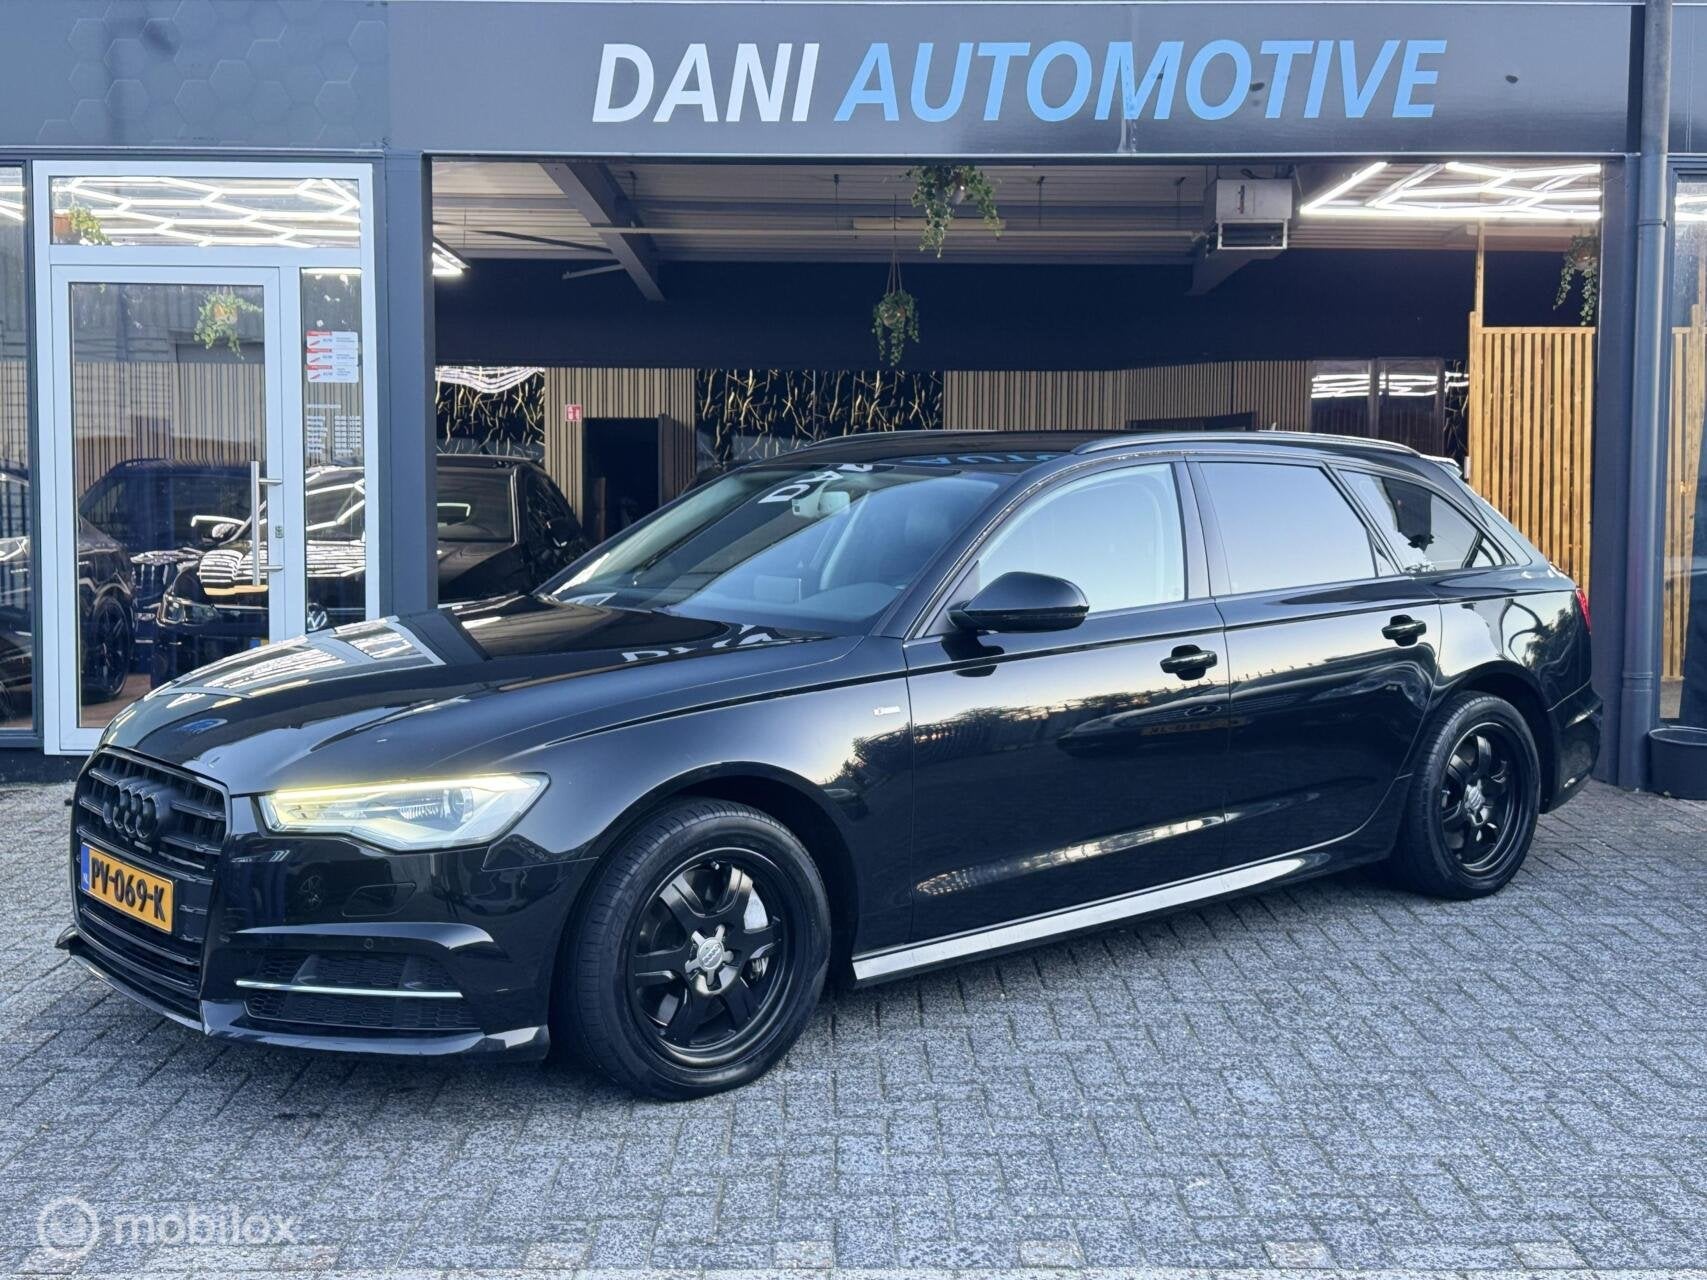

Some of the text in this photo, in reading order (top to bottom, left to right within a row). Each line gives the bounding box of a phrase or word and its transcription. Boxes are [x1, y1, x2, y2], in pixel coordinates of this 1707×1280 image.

[592, 39, 1448, 122] DANI AUTOMOTIVE
[91, 857, 166, 922] PV-069-K
